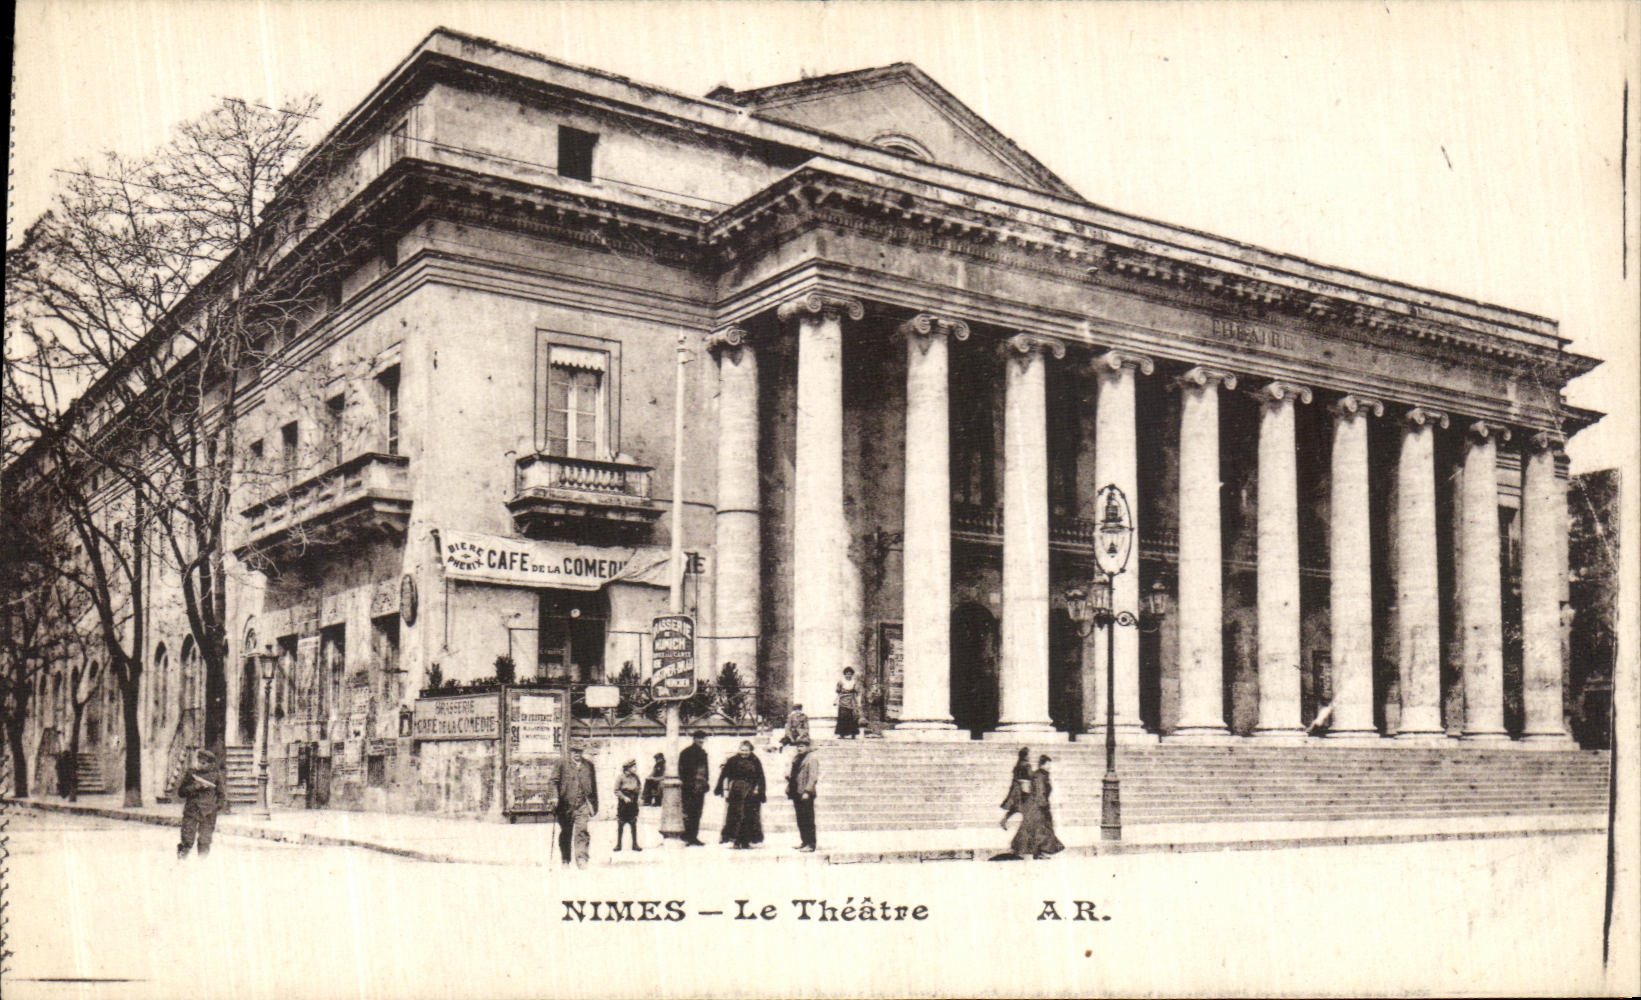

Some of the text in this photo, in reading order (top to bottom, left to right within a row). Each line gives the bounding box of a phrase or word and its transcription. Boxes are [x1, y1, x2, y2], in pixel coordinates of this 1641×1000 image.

[448, 542, 484, 557] BIERE
[448, 555, 484, 570] PHENIX
[487, 549, 529, 572] CAFE
[531, 565, 545, 573] DE
[547, 565, 561, 574] LA
